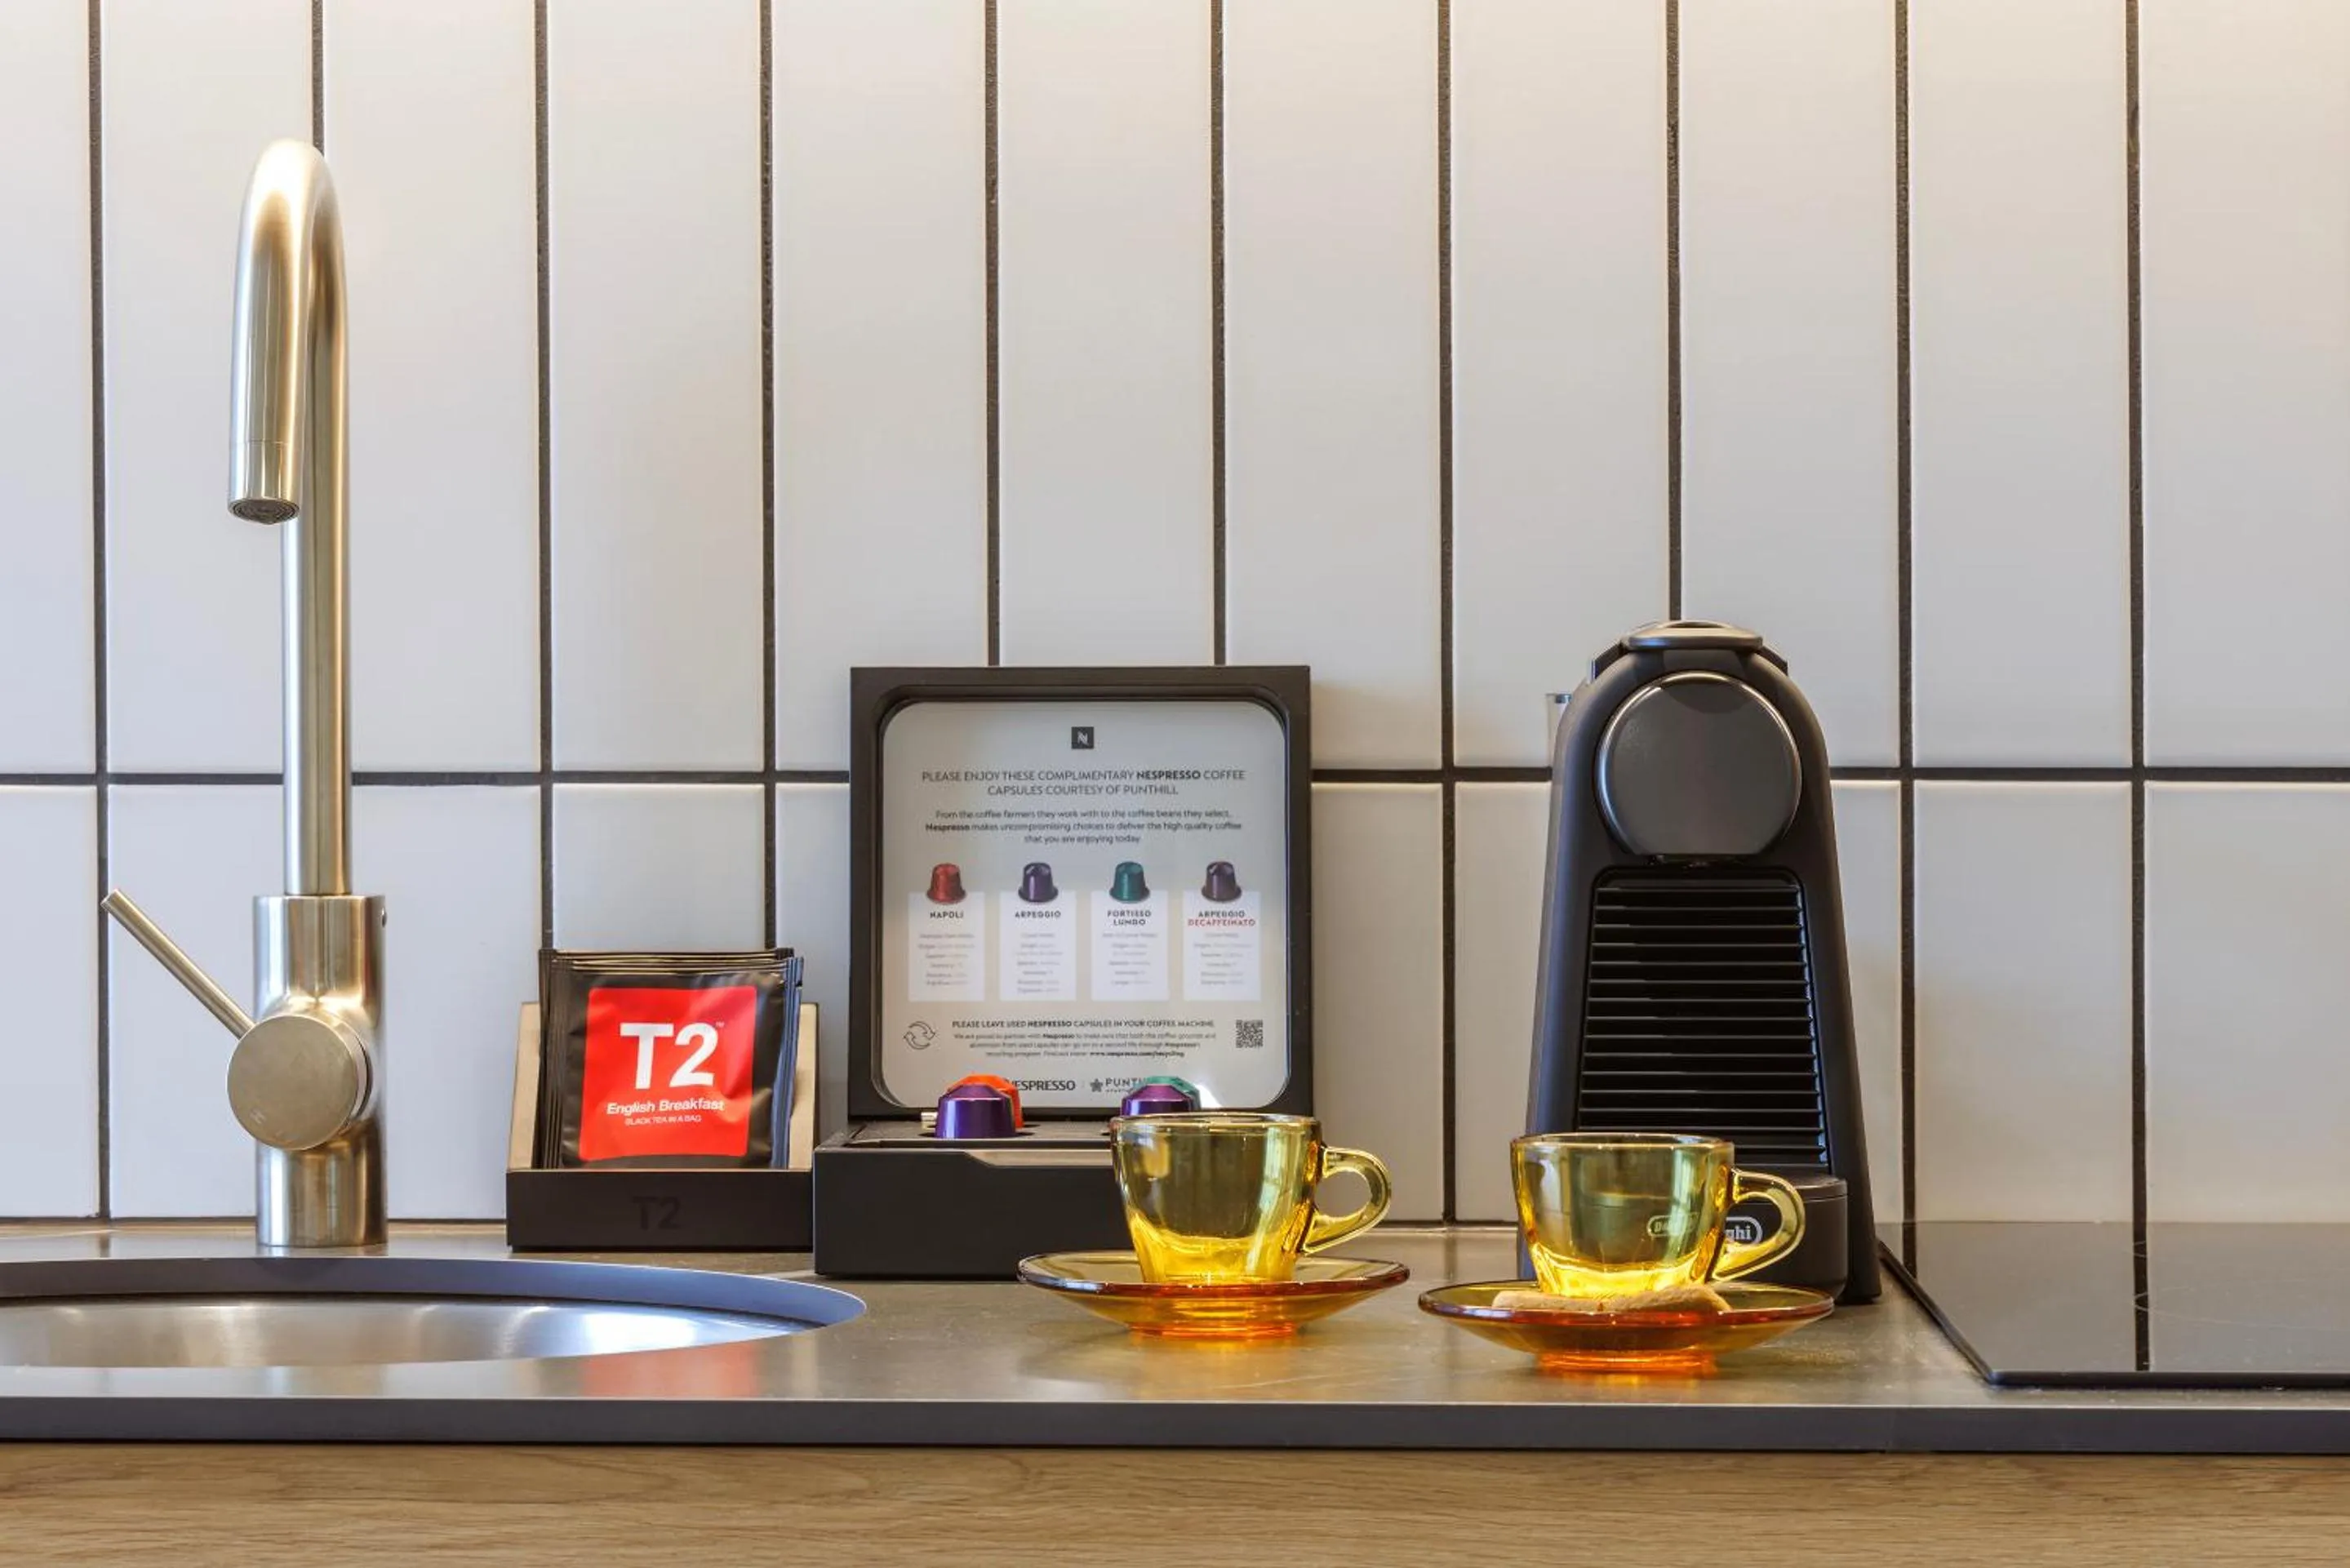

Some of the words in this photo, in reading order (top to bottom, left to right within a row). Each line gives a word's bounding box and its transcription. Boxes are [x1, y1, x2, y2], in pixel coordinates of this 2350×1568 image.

[922, 771, 962, 782] PLEASE
[964, 771, 999, 781] ENJOY
[1002, 770, 1034, 781] THESE
[1037, 770, 1134, 781] COMPLIMENTARY
[1136, 769, 1201, 780] NESPRESSO
[1203, 769, 1246, 780] COFFEE
[988, 785, 1042, 795] CAPSULES
[1045, 785, 1103, 795] COURTESY
[1105, 785, 1121, 795] OF
[1123, 785, 1179, 795] PUNTHILL
[930, 911, 964, 919] NAPOLI
[1015, 911, 1062, 919] ARPEGGIO
[1198, 910, 1246, 918] ARPEGGIO
[1188, 919, 1256, 927] DECAFFEINATO
[952, 1020, 980, 1028] PLEASE
[981, 1020, 1006, 1028] LEAVE
[1006, 1020, 1027, 1028] USED
[1028, 1020, 1073, 1028] NESPRESSO
[1073, 1020, 1113, 1028] CAPSULES
[1113, 1019, 1122, 1028] IN
[1123, 1019, 1144, 1028] YOUR
[1146, 1019, 1177, 1028] COFFEE
[620, 1022, 718, 1090] T2
[606, 1101, 655, 1116] English
[659, 1097, 726, 1111] Breakfast
[624, 1117, 651, 1126] BLACK
[651, 1116, 668, 1124] TEA
[684, 1114, 702, 1122] BAG
[632, 1197, 682, 1230] T2
